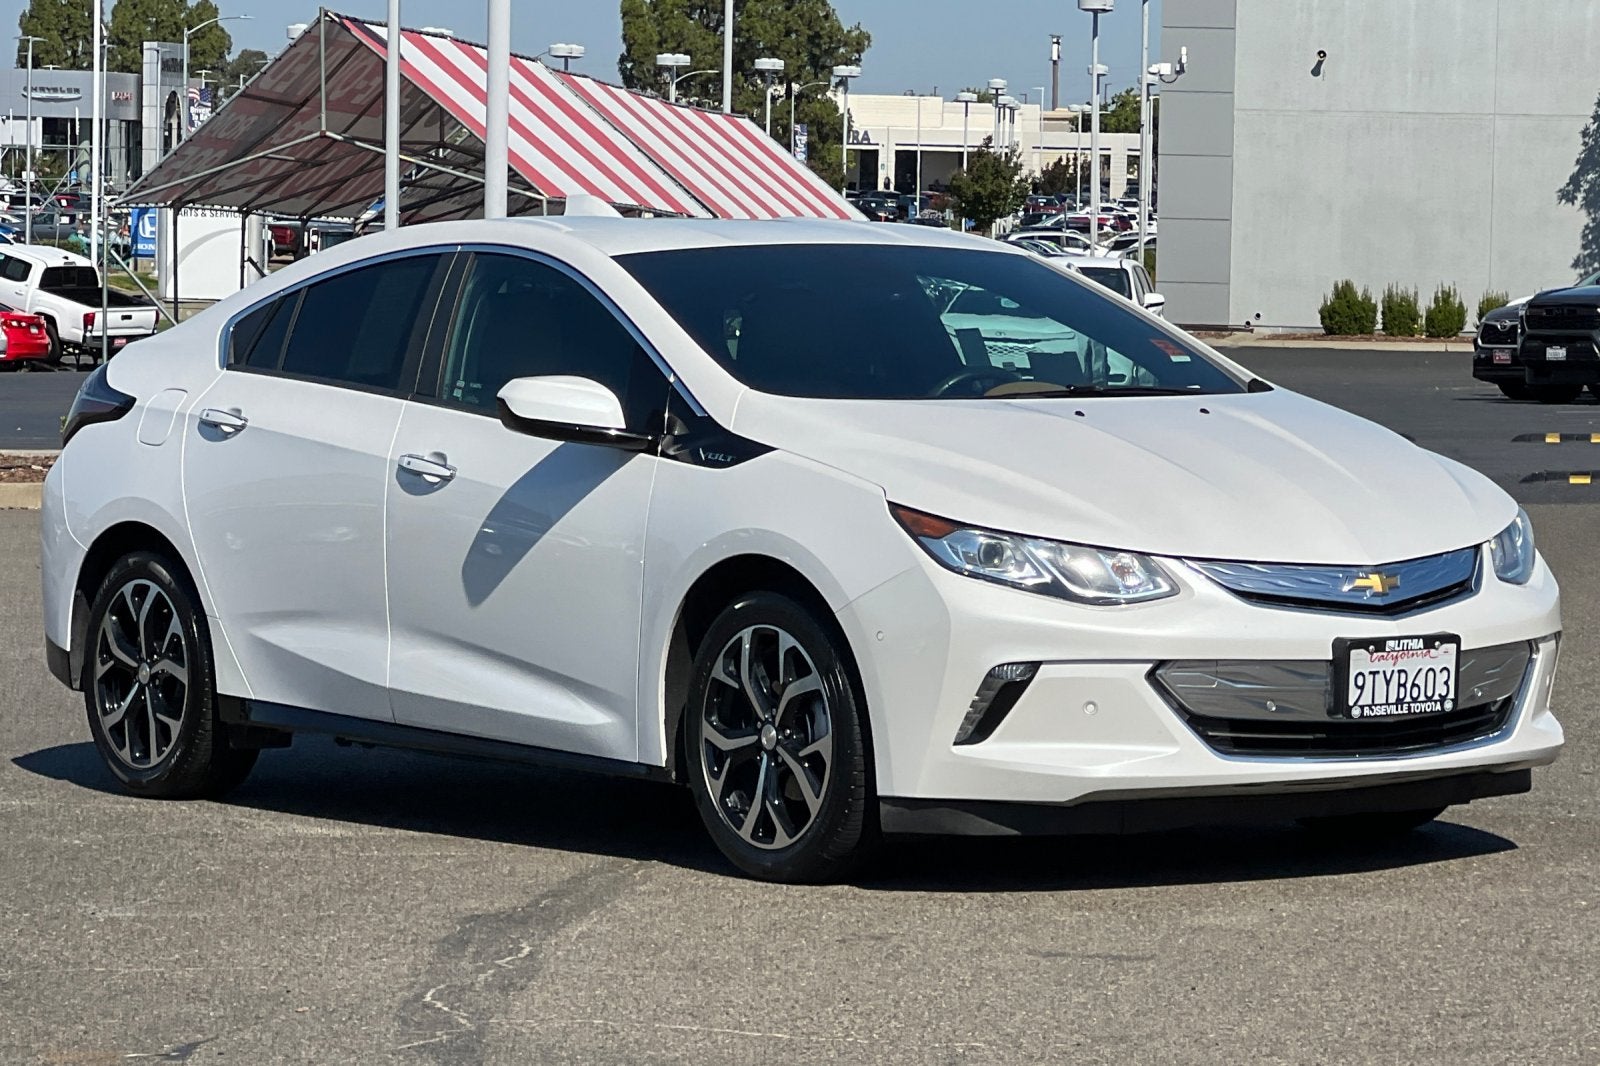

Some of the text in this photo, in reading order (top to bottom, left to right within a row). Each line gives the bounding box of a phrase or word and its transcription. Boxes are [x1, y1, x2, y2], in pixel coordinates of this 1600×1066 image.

[23, 86, 81, 94] CHRYSLER
[178, 208, 199, 217] ARTS
[700, 447, 735, 462] VOLT
[1394, 638, 1424, 650] LITHIA
[1370, 650, 1439, 666] California
[1354, 667, 1451, 705] 9TYB603
[1363, 701, 1441, 717] ROSEVILLE TOYOTA
